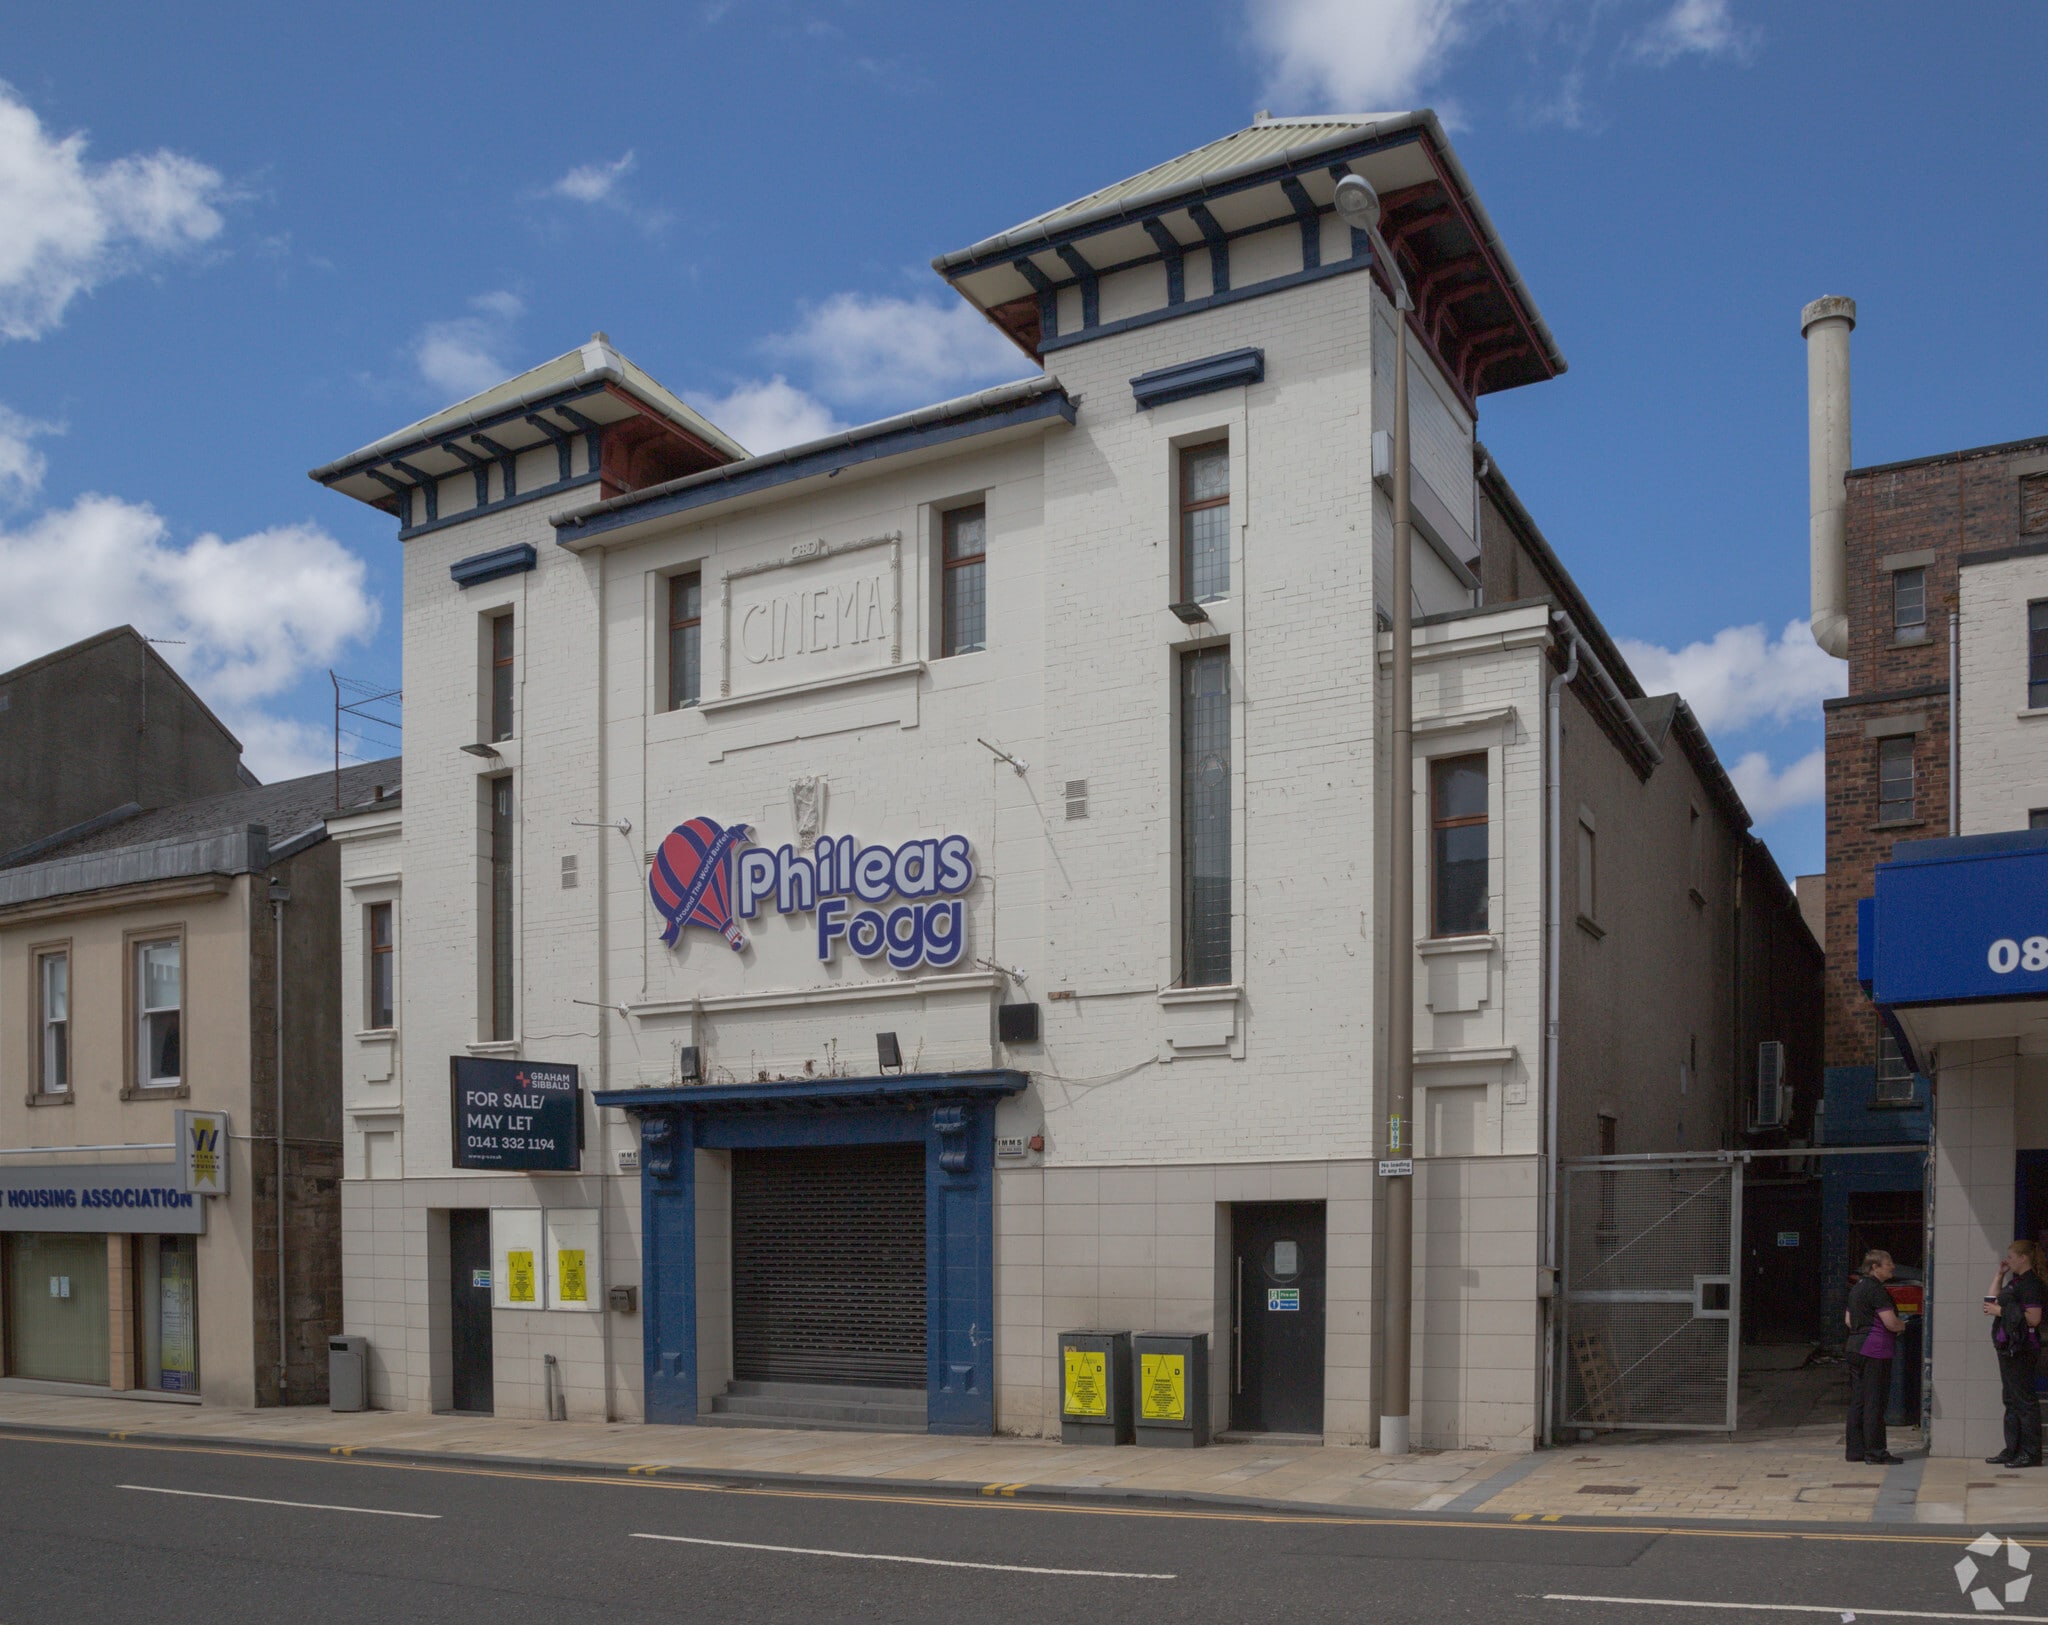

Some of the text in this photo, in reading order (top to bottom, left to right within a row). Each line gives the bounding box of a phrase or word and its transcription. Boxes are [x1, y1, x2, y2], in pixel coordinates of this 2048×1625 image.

[742, 577, 886, 664] CINEMA
[675, 832, 729, 923] Around The World Buffet
[738, 834, 975, 919] Phileas
[816, 898, 968, 971] Fogg
[1987, 936, 2048, 974] 08
[530, 1072, 570, 1082] GRAHAM
[531, 1080, 570, 1090] SIBBALD
[466, 1091, 545, 1109] FOR SALE/
[467, 1113, 533, 1131] MAY LET
[467, 1135, 555, 1150] 0141 332 1194
[7, 1188, 77, 1208] HOUSING
[81, 1188, 193, 1208] ASSOCIATION
